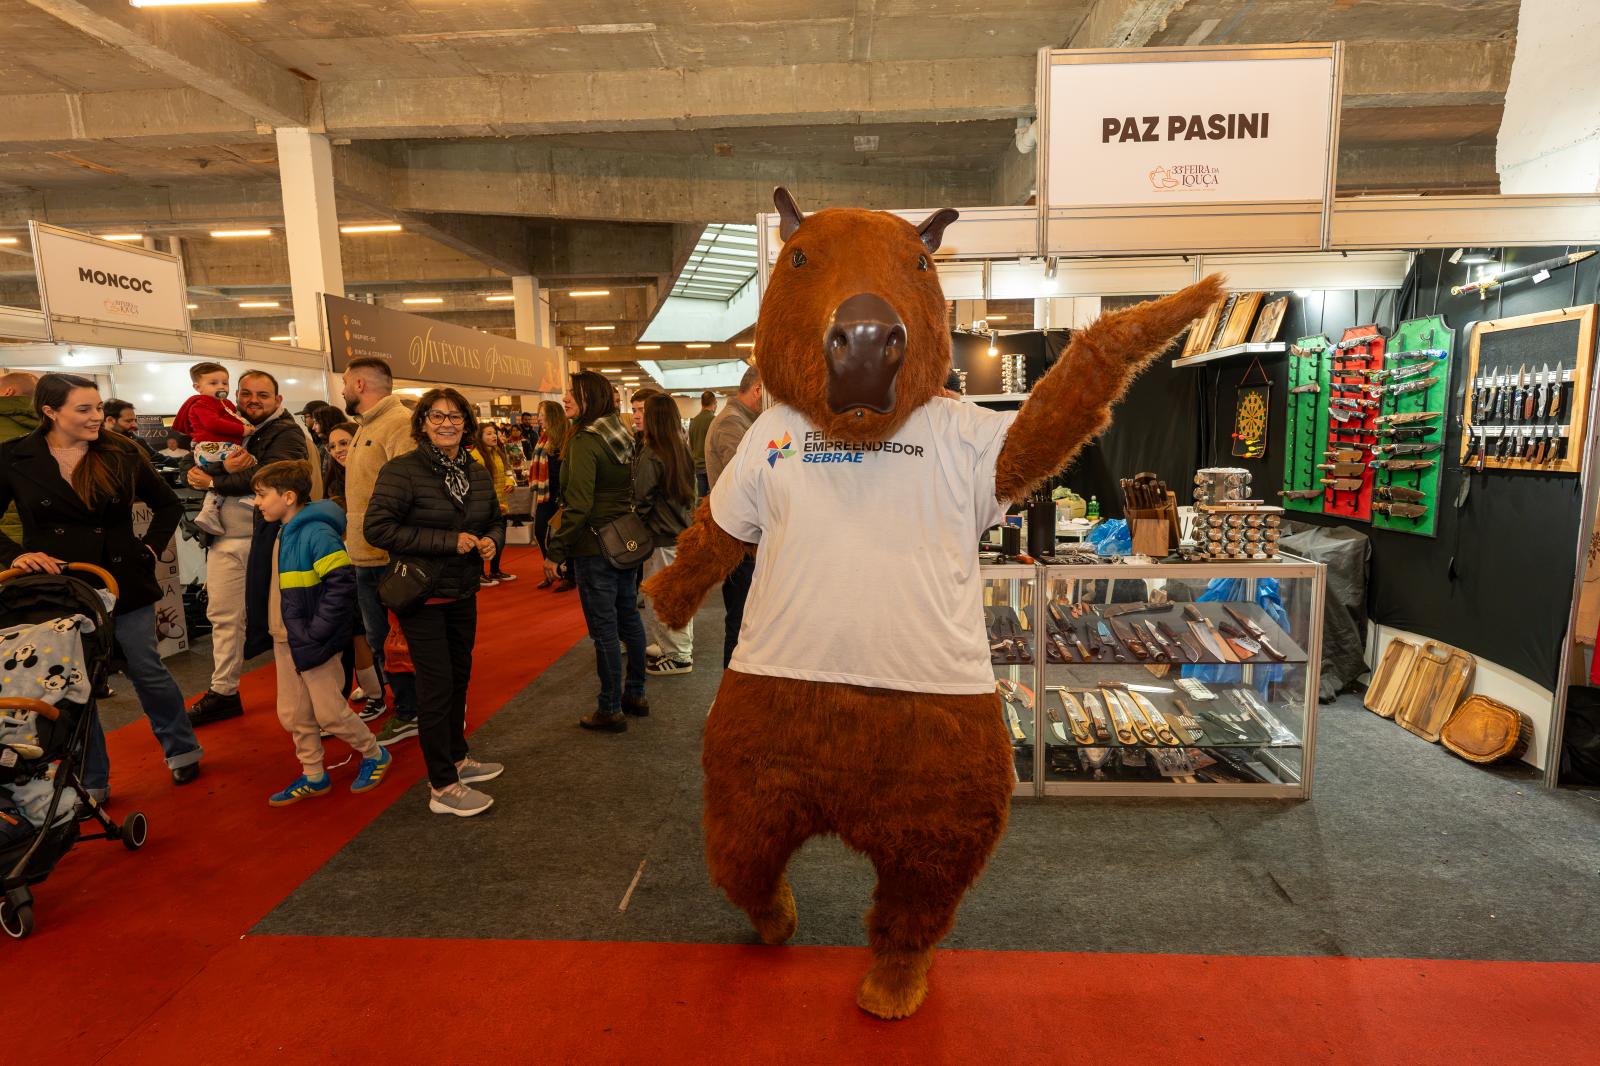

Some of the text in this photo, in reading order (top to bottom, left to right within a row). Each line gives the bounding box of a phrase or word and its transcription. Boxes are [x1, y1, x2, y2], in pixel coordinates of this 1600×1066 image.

[1102, 112, 1270, 144] PAZ PASINI
[1184, 164, 1210, 175] FEIRA
[1211, 167, 1220, 175] DA
[1181, 174, 1220, 188] LOUÇA
[78, 266, 153, 294] MONCOC
[408, 326, 481, 375] VIVÊNCIAS
[804, 430, 828, 441] FEI
[803, 441, 924, 457] EMPREENDEDOR
[802, 451, 864, 464] SEBRAE
